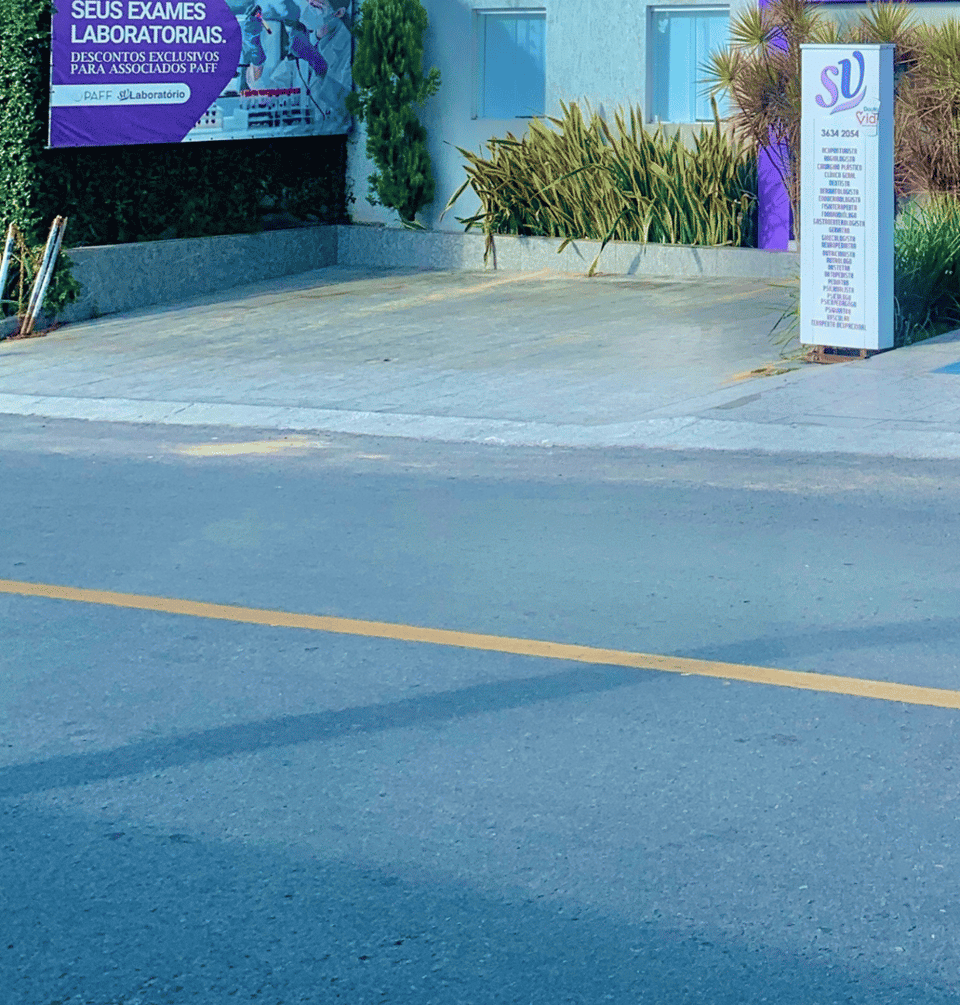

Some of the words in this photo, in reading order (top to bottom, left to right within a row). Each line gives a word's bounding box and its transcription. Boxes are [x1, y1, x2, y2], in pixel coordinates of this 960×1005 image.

[71, 0, 123, 19] SEUS
[128, 1, 206, 20] EXAMES
[70, 24, 227, 44] LABORATORIAIS.
[70, 51, 146, 63] DESCONTOS
[149, 51, 220, 62] EXCLUSIVOS
[70, 63, 105, 75] PARA
[108, 63, 187, 74] ASSOCIADOS
[189, 62, 218, 73] PAFF
[84, 90, 113, 101] PAFF
[129, 90, 186, 100] Laboratório
[821, 129, 839, 137] 3634
